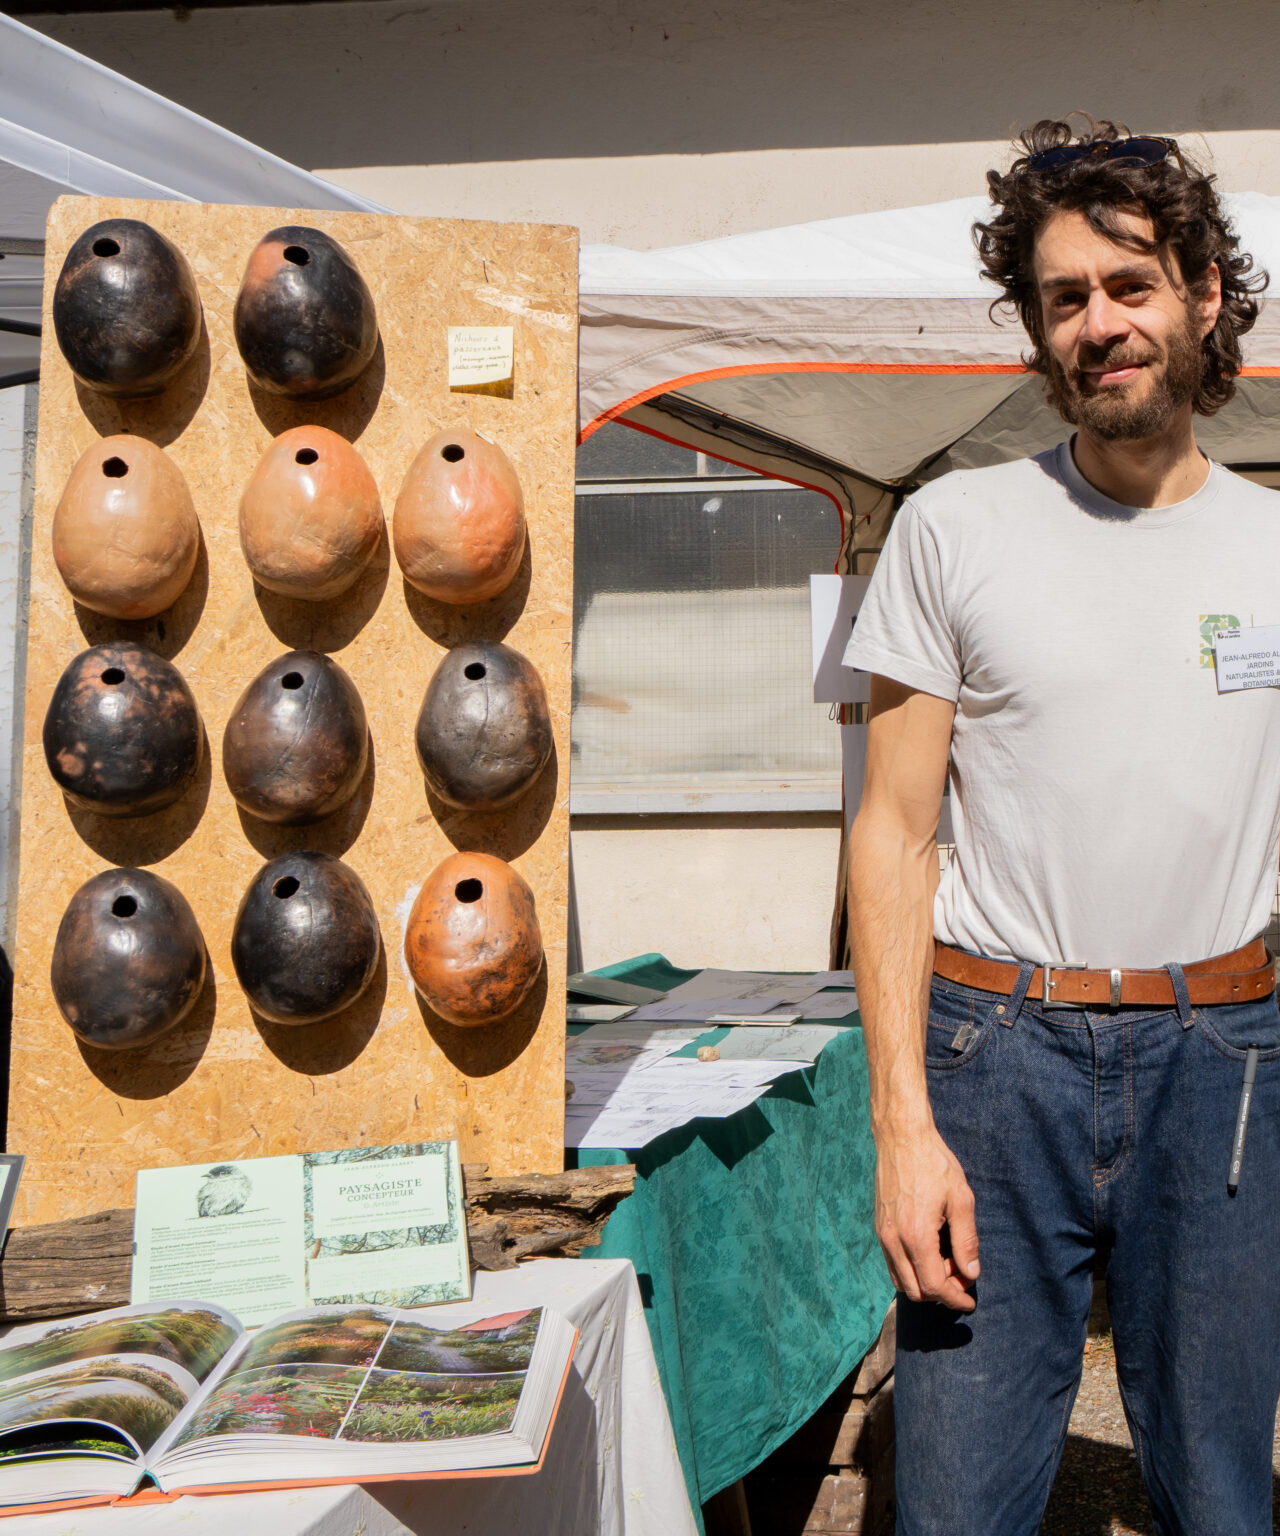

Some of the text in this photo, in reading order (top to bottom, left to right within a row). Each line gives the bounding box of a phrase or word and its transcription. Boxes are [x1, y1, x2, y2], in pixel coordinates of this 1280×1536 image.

[1222, 652, 1271, 662] JEAN-ALFREDO
[1246, 661, 1274, 669] JARDINS
[1225, 669, 1275, 680] NATURALISTES
[1242, 678, 1280, 688] BOTANIQUE
[339, 1178, 422, 1195] PAYSAGISTE
[347, 1189, 415, 1202] CONCEPTEUR
